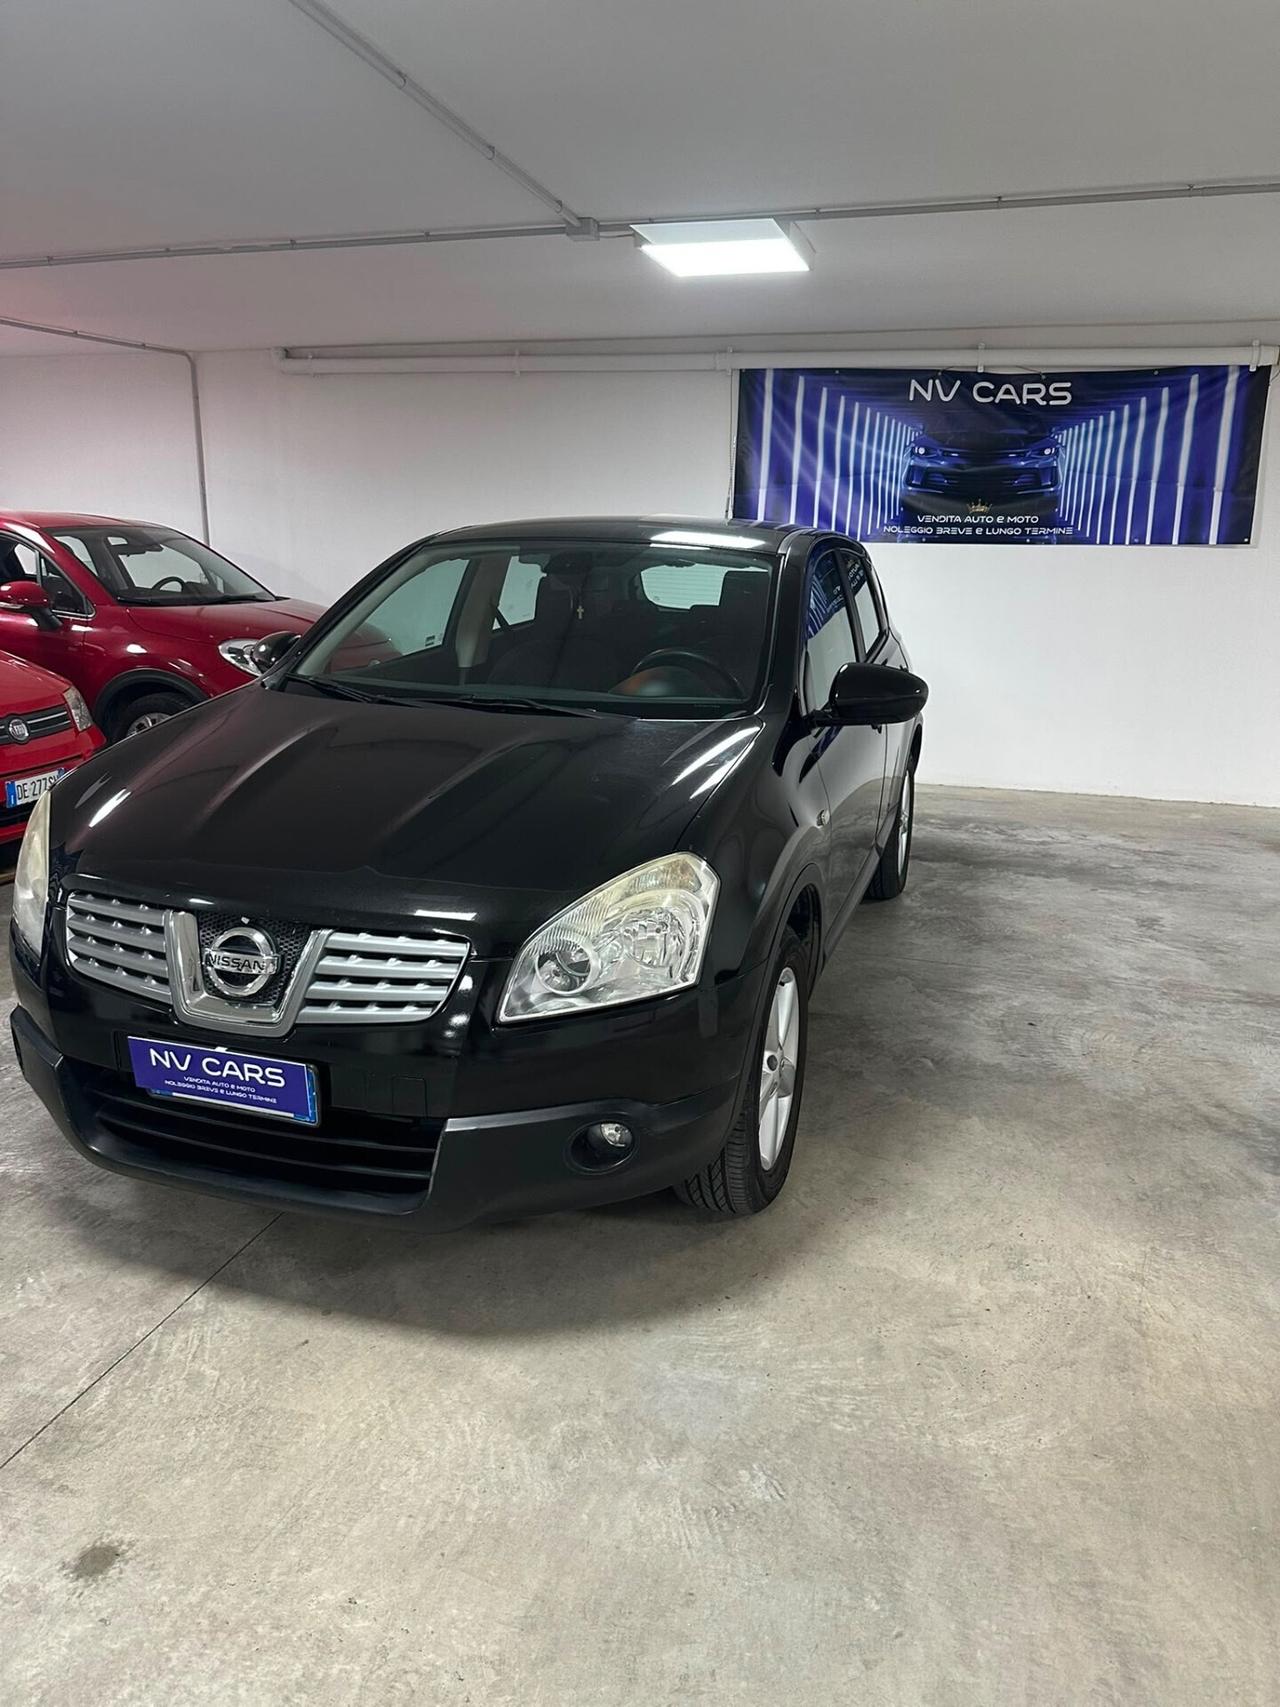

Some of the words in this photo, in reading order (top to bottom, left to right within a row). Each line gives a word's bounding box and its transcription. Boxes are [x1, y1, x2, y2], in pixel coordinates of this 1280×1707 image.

[909, 378, 961, 402] NV
[972, 381, 1073, 406] CARS
[917, 514, 962, 523] VENDITA
[964, 515, 994, 524] AUTO
[1007, 515, 1040, 524] MOTO
[883, 525, 934, 535] NOLEGGIO
[936, 526, 973, 535] BREVE
[986, 527, 1022, 535] LUNGO
[1024, 526, 1073, 535] TERMINE
[16, 783, 29, 800] DE
[206, 952, 265, 971] NISSAN
[149, 1047, 192, 1071] NV
[201, 1057, 286, 1088] CARS
[211, 1081, 230, 1089] AUTO
[236, 1085, 256, 1093] MOTO
